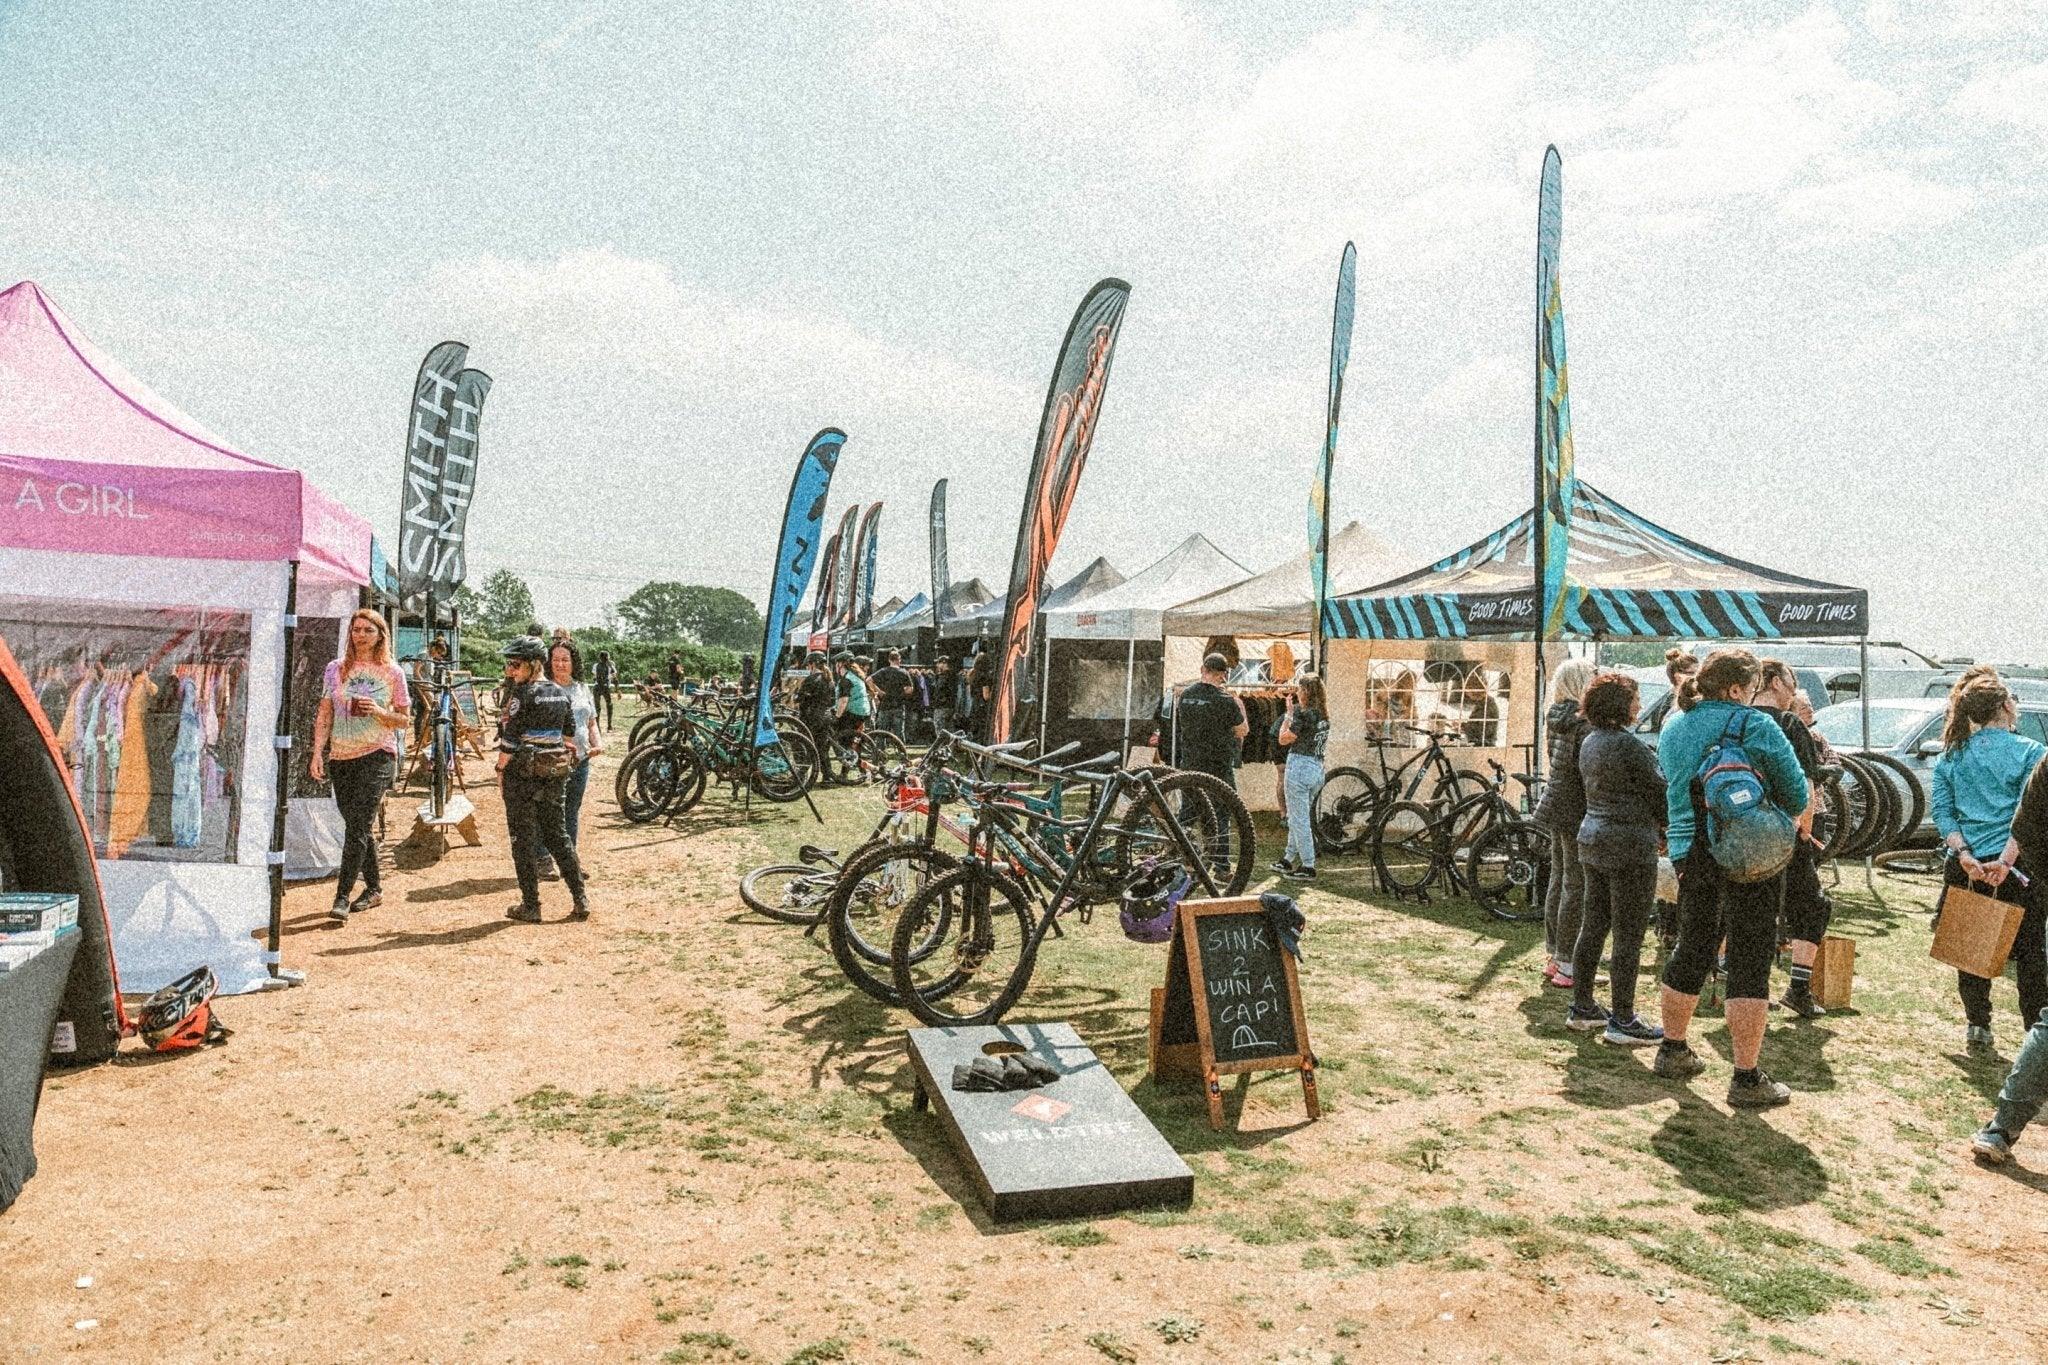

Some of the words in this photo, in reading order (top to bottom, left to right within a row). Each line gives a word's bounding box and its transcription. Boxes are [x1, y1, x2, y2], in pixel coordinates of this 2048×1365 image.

[402, 369, 459, 579] SMITH
[15, 478, 45, 513] A
[55, 481, 152, 519] GIRL
[431, 399, 479, 583] SMITH
[1468, 602, 1497, 621] GOOD
[1779, 603, 1814, 622] GOOD
[1208, 927, 1271, 951] SINK
[1232, 956, 1250, 976] 2
[1209, 978, 1251, 996] WIN
[1261, 975, 1277, 994] A
